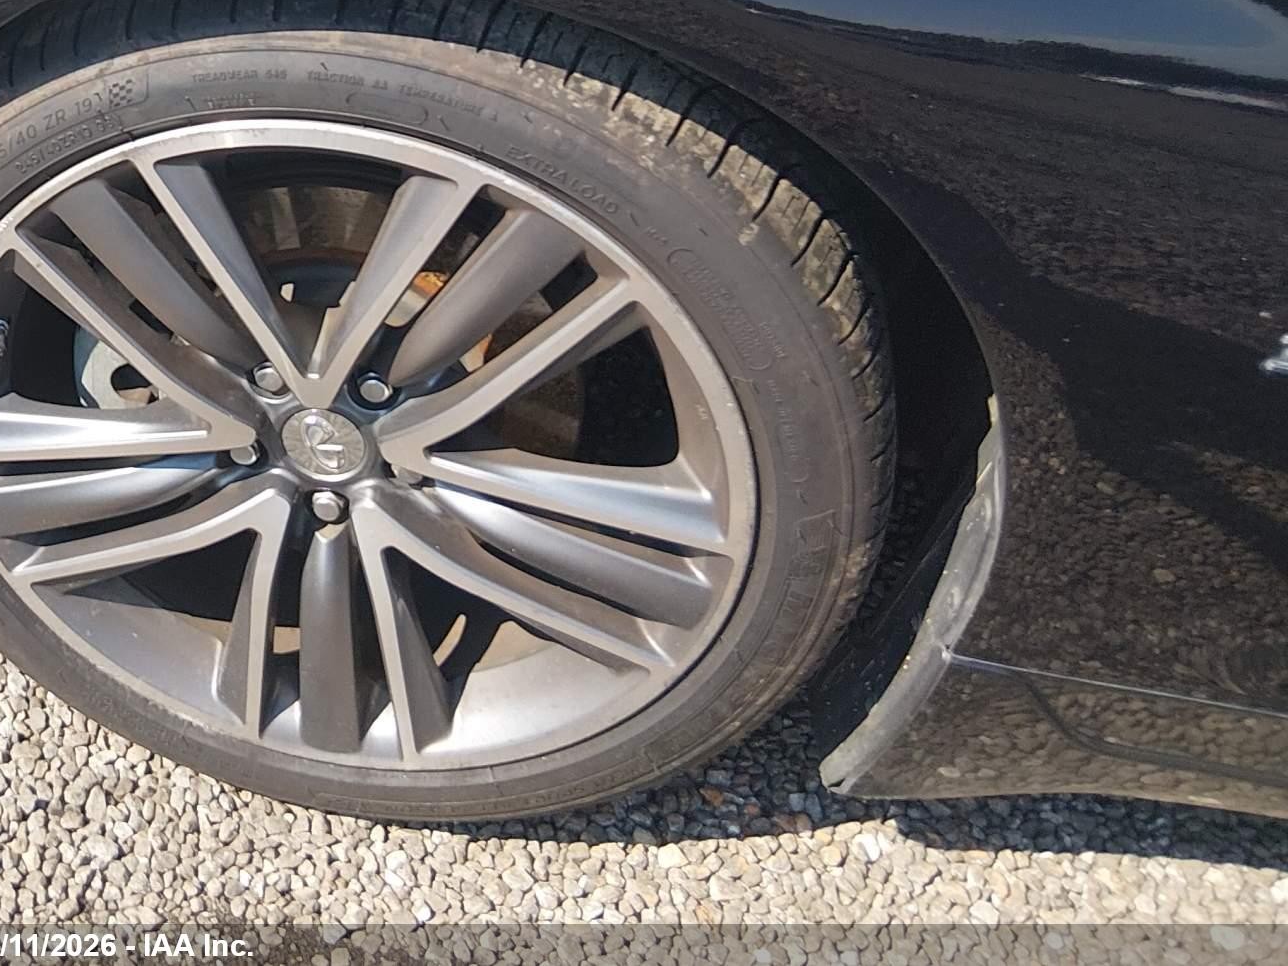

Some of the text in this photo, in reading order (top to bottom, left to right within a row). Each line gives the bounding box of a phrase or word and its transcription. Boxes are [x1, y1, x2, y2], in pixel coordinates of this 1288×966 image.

[43, 108, 67, 131] ZR
[74, 97, 93, 116] 19
[505, 143, 619, 214] EXTRA LOAD
